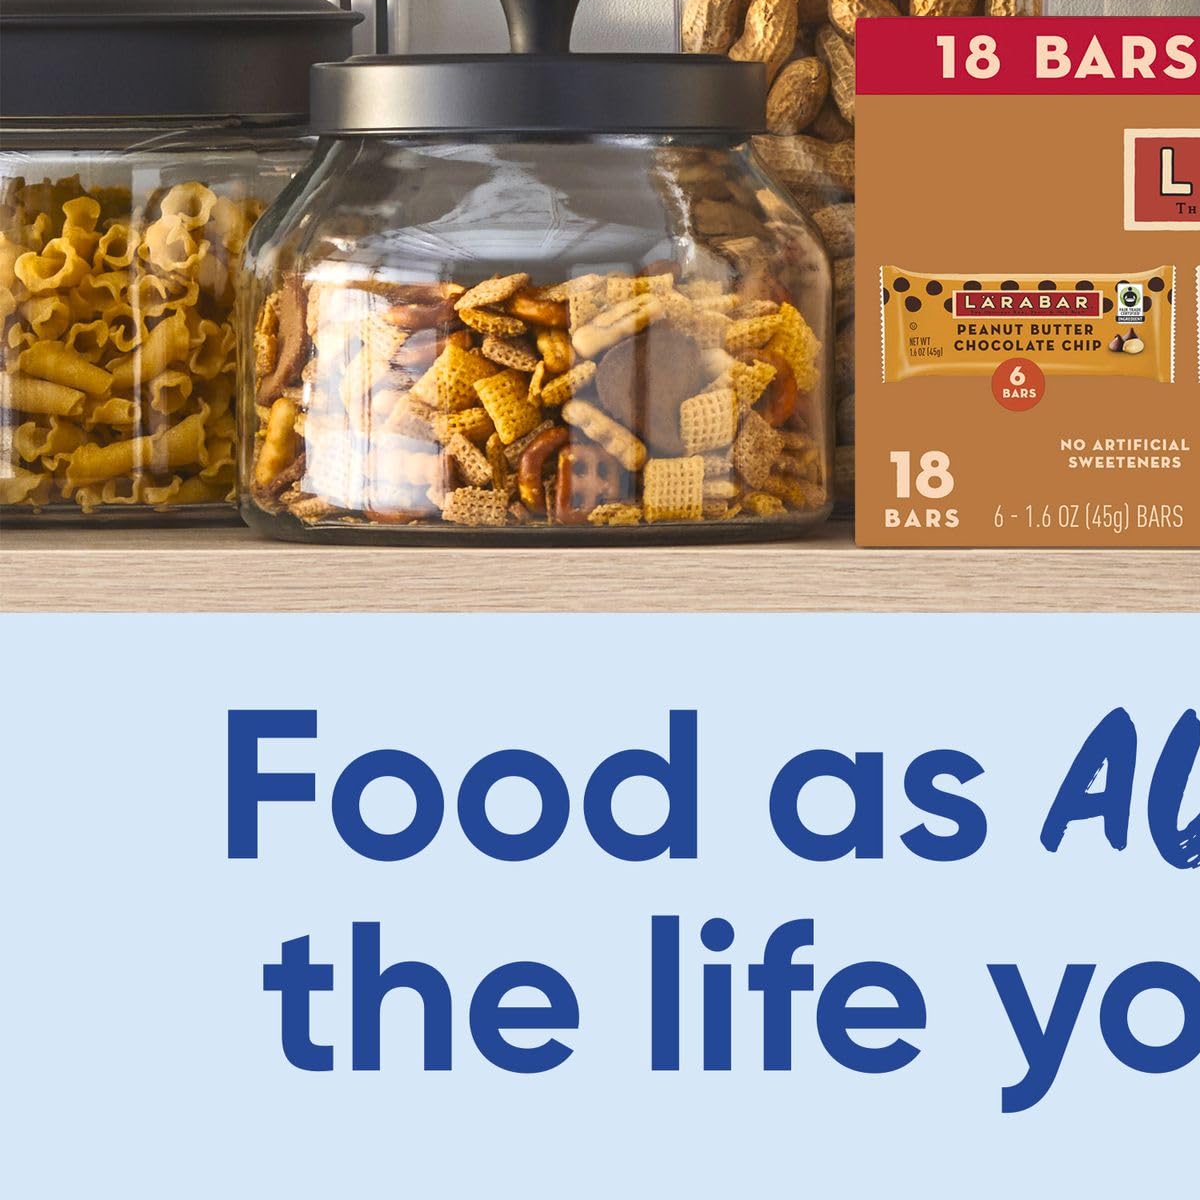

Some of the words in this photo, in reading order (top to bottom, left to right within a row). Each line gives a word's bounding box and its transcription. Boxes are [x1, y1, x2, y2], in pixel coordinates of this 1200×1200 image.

[937, 35, 1000, 79] 18
[1036, 35, 1196, 79] BARS
[957, 323, 1024, 336] PEANUT
[1030, 323, 1094, 336] BUTTER
[909, 336, 919, 346] NET
[920, 336, 931, 346] WT
[953, 339, 1055, 352] CHOCOLATE
[1061, 339, 1102, 352] CHIP
[1009, 365, 1026, 386] 6
[1002, 388, 1037, 399] BARS
[1060, 438, 1086, 451] NO
[1092, 438, 1190, 451] ARTIFICIAL
[1068, 456, 1182, 469] SWEETENERS
[890, 450, 955, 499] 18
[885, 508, 960, 528] BARS
[994, 504, 1004, 528] 6
[1025, 504, 1051, 528] 1.6
[1058, 504, 1080, 528] OZ
[1085, 502, 1129, 534] (45g)
[1137, 504, 1184, 528] BARS
